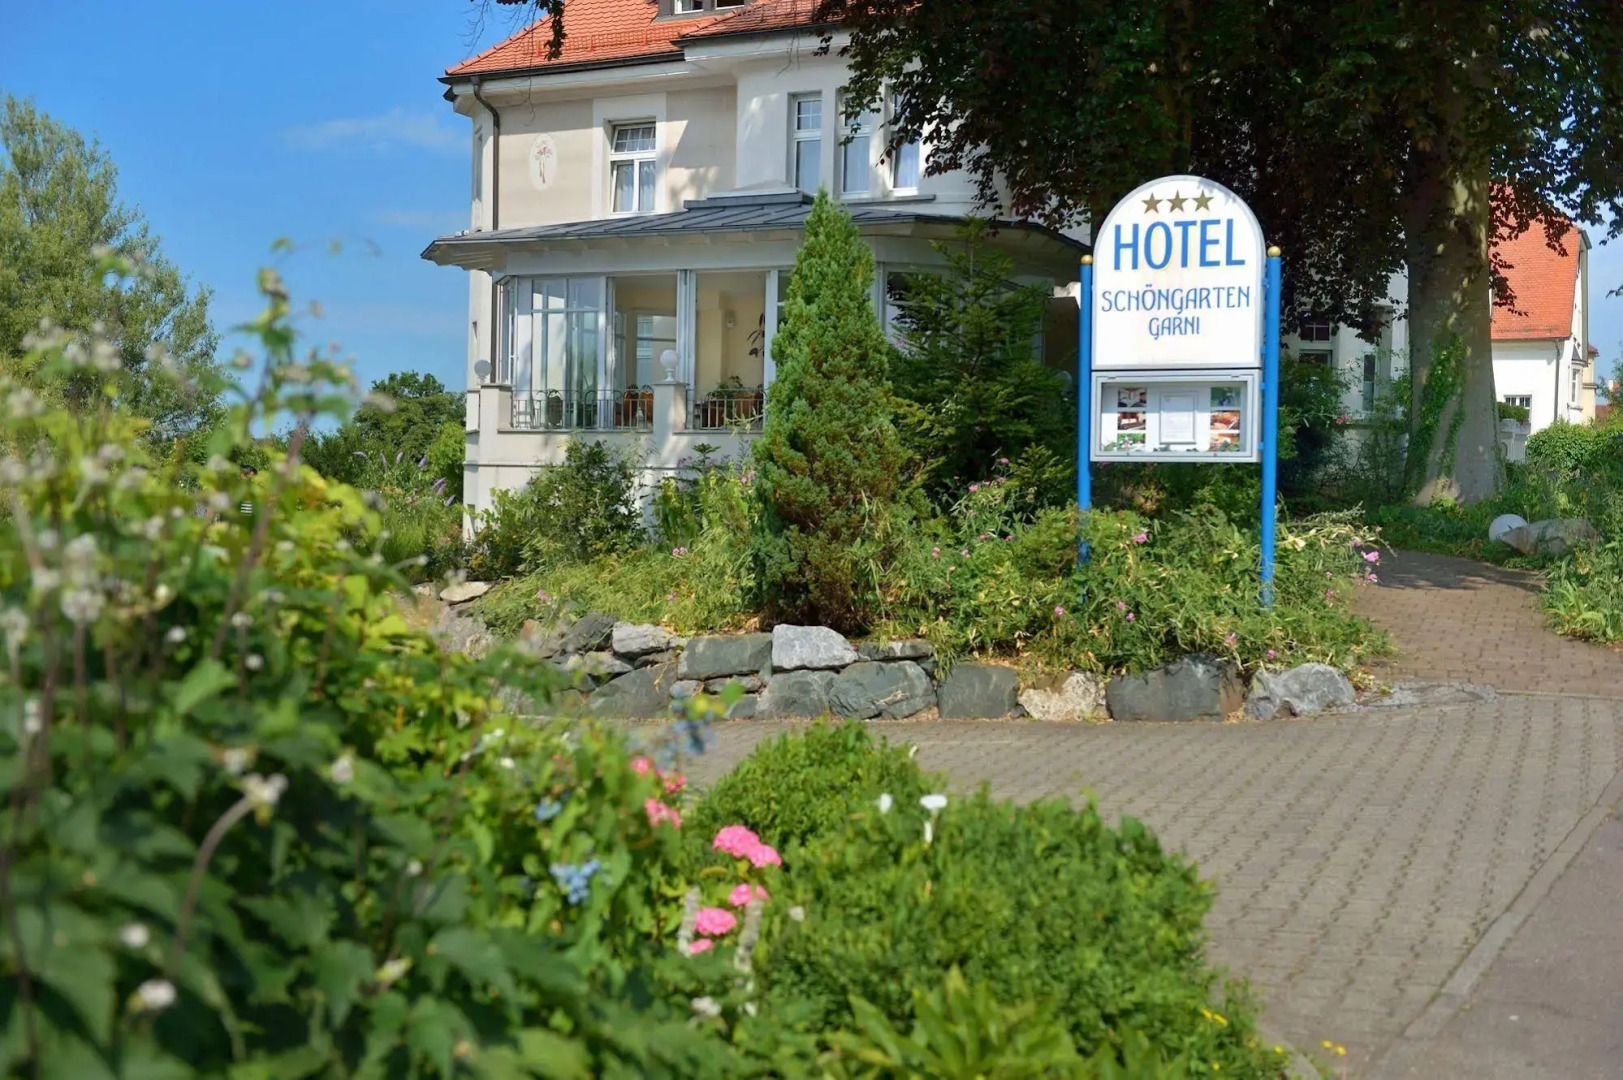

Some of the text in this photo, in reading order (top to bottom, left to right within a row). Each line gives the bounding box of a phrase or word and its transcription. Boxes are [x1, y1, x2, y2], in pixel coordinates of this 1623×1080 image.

[1113, 218, 1246, 271] HOTEL
[1101, 283, 1251, 315] SCHÖNGARTEN
[1148, 316, 1201, 341] GARNI
